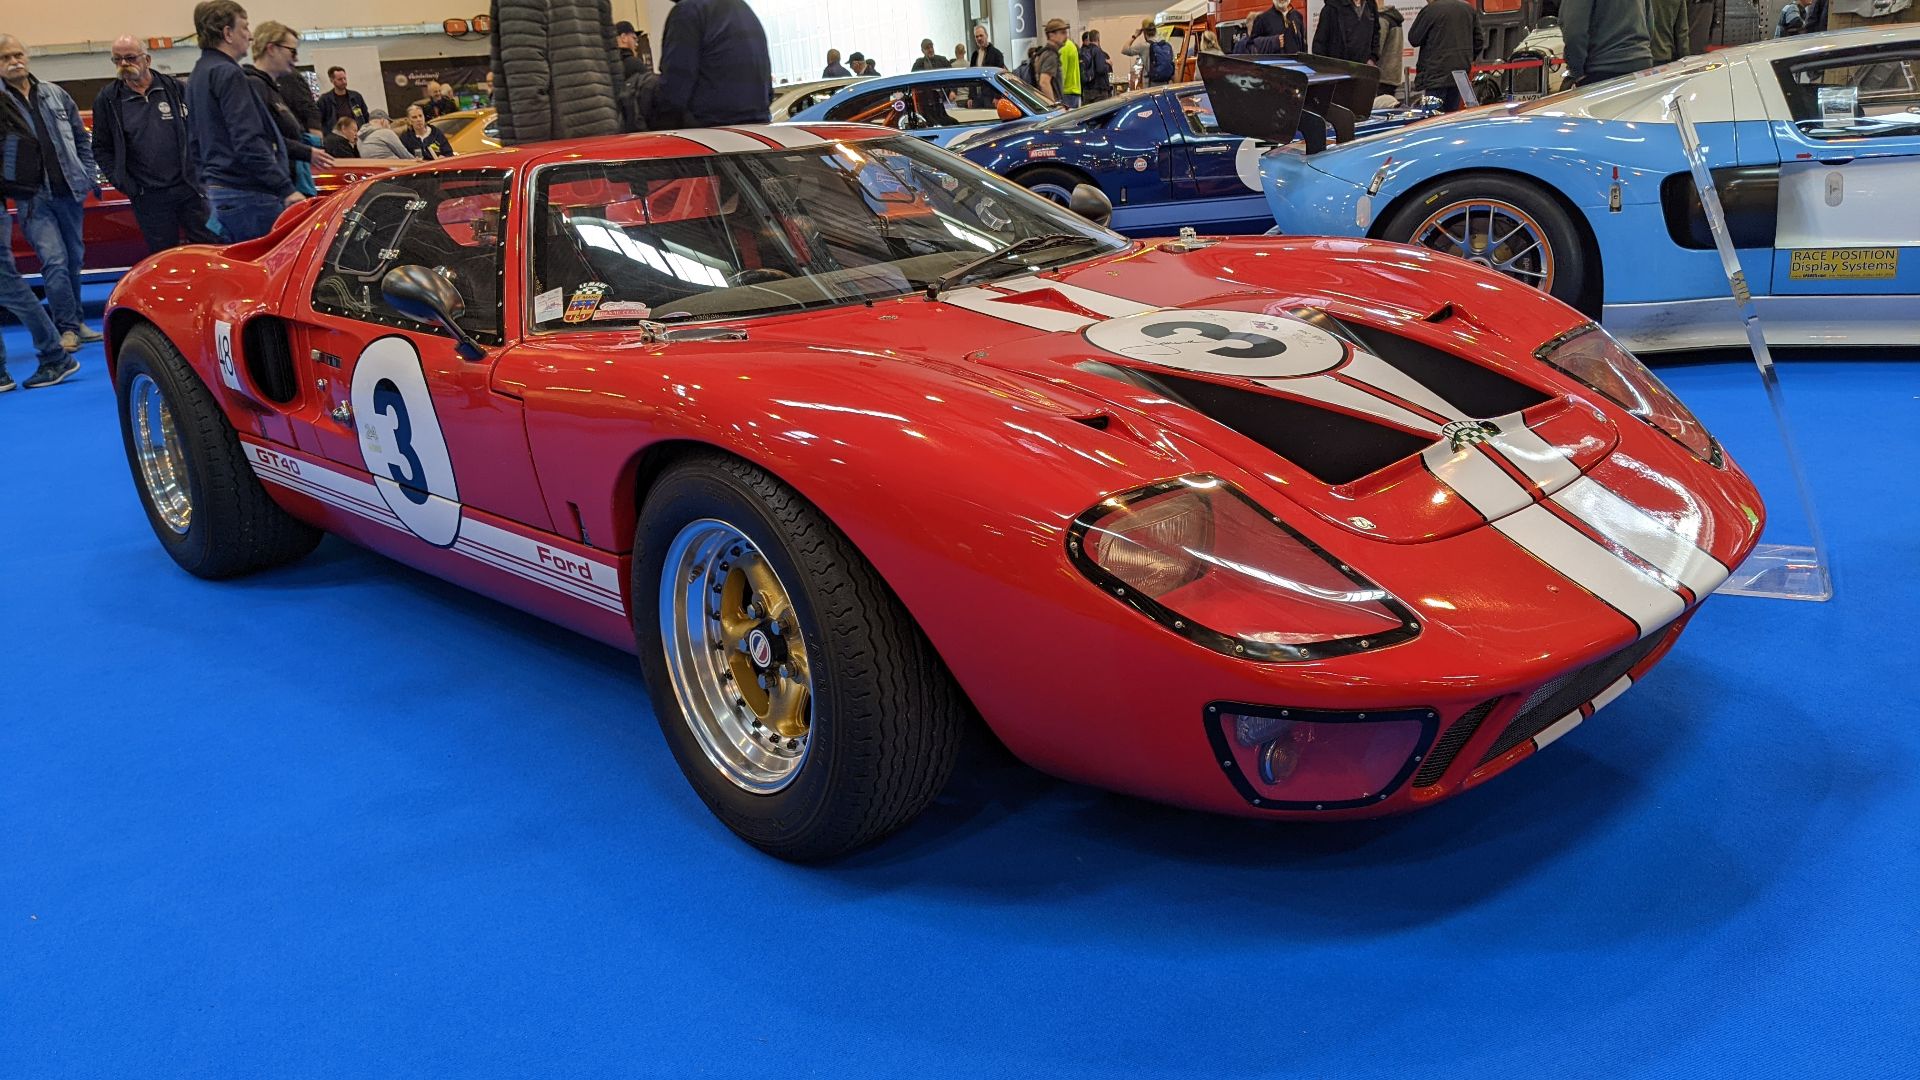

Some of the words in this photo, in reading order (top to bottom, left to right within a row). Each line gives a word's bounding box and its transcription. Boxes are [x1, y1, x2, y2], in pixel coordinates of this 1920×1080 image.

[1014, 3, 1025, 33] 3
[1030, 150, 1056, 158] MOTUL
[1792, 262, 1838, 272] Display
[1842, 261, 1895, 272] Systems
[1794, 251, 1827, 261] RACE
[1832, 250, 1895, 260] POSITION
[218, 334, 233, 376] 48
[1141, 321, 1288, 359] 3
[373, 378, 429, 505] 3
[255, 448, 301, 475] GT40
[536, 545, 593, 581] Ford
